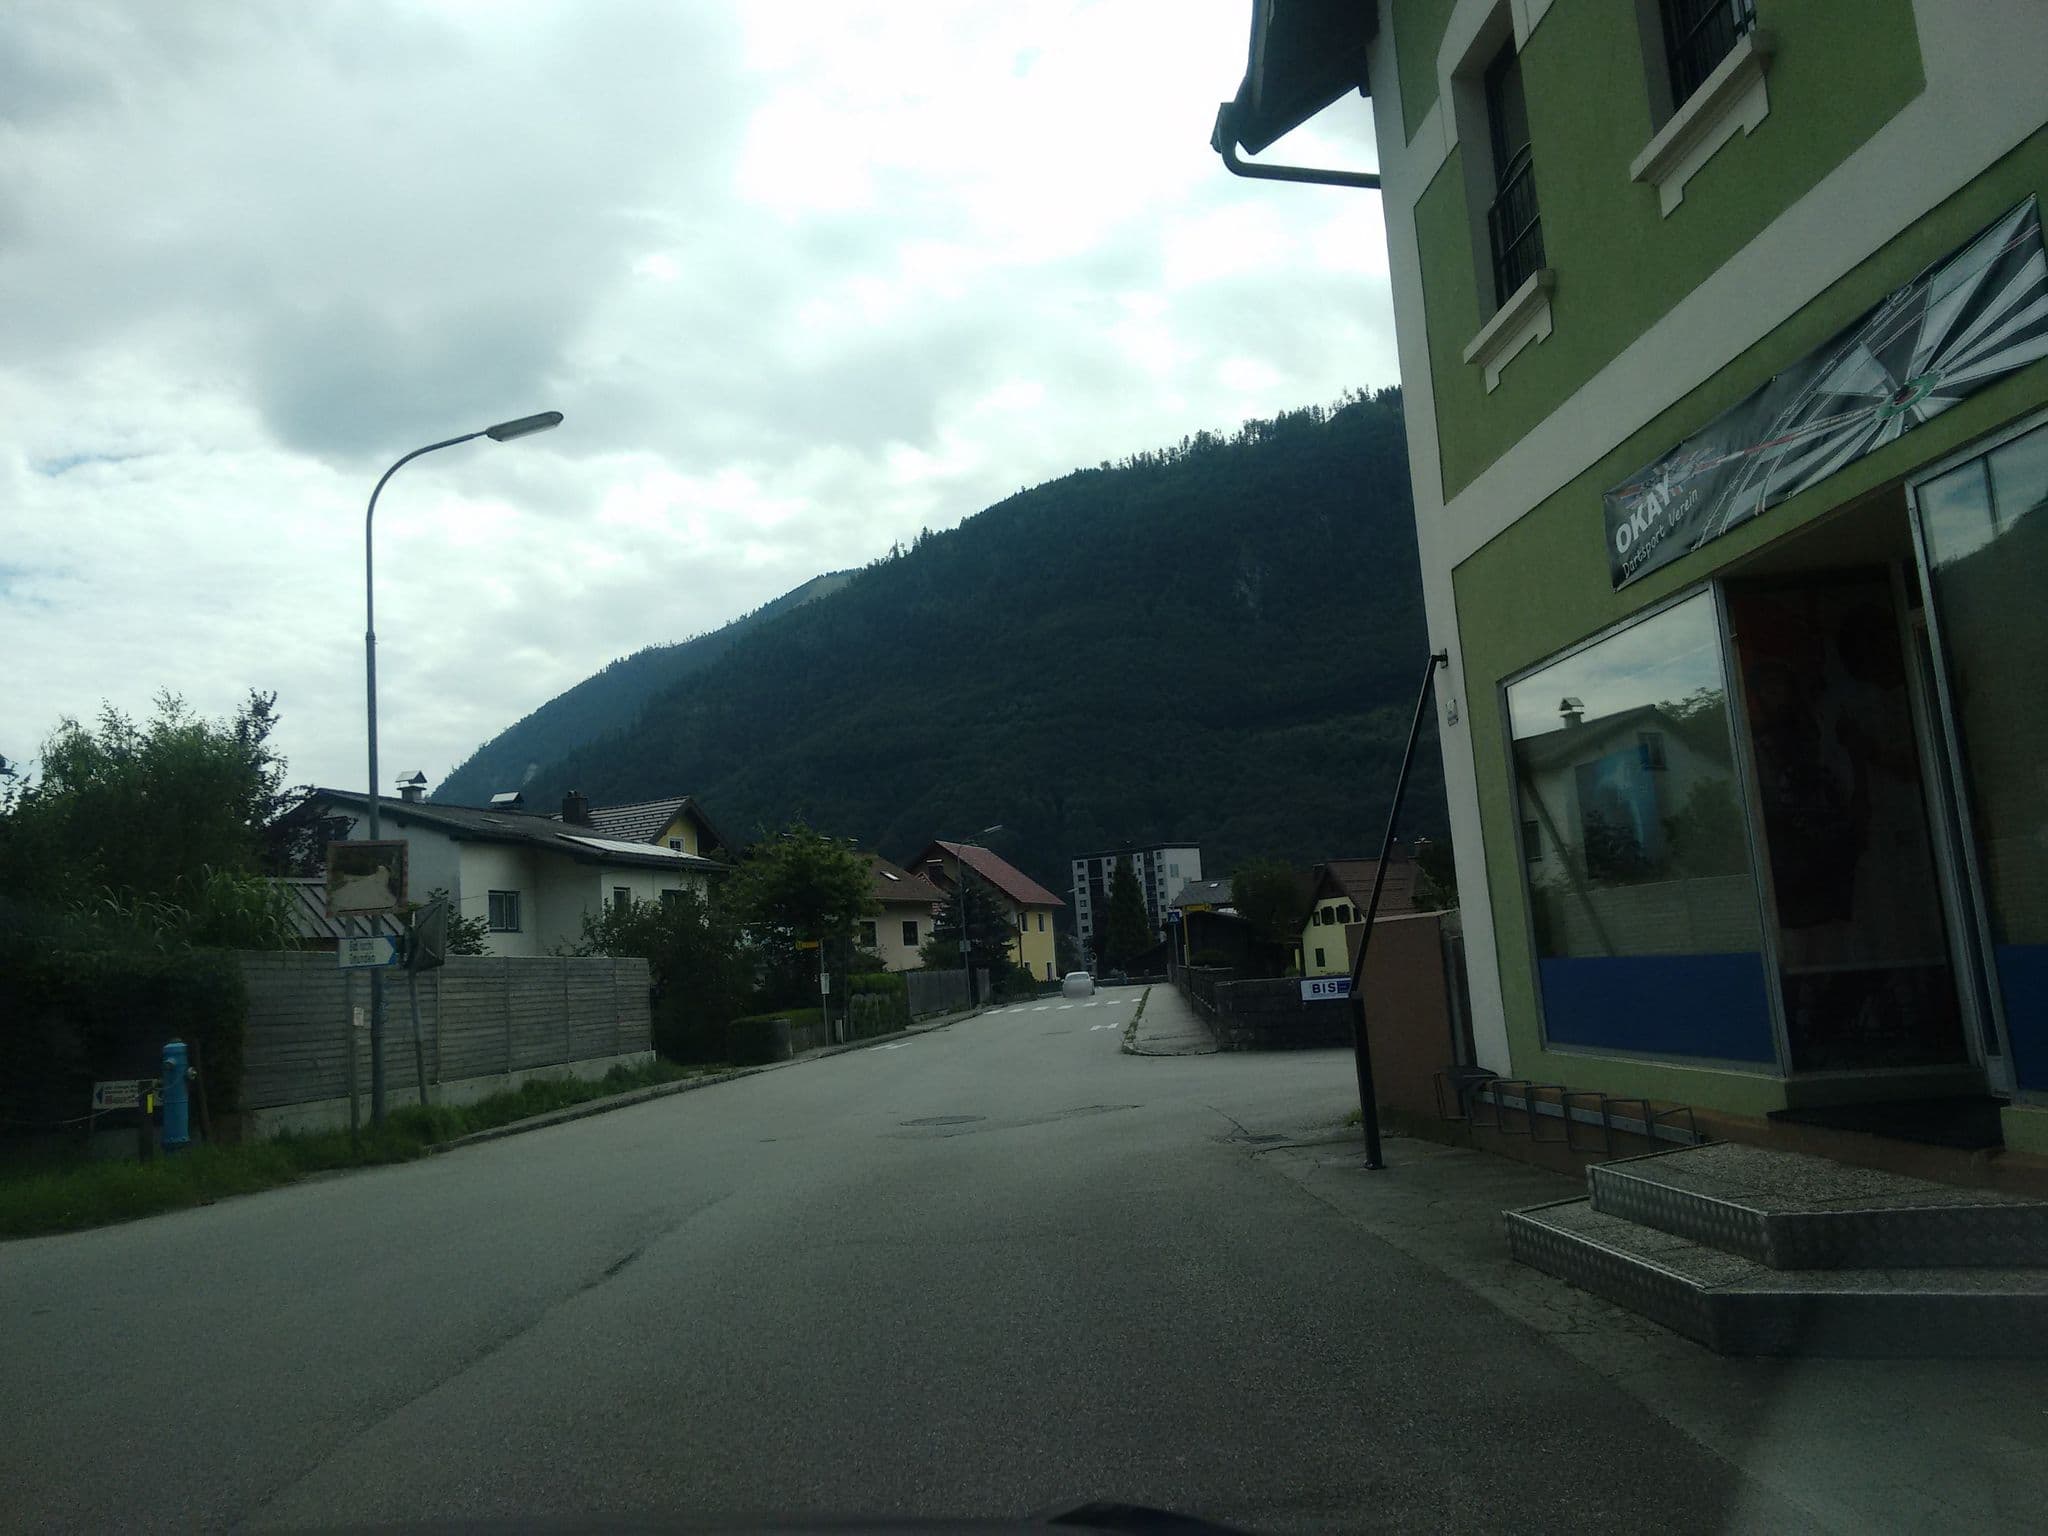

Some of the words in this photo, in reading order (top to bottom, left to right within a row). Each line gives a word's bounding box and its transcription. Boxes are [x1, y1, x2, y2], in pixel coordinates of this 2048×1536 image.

[1616, 472, 1671, 554] OKAY
[1622, 525, 1666, 579] Dartsport
[1668, 489, 1699, 527] Verein
